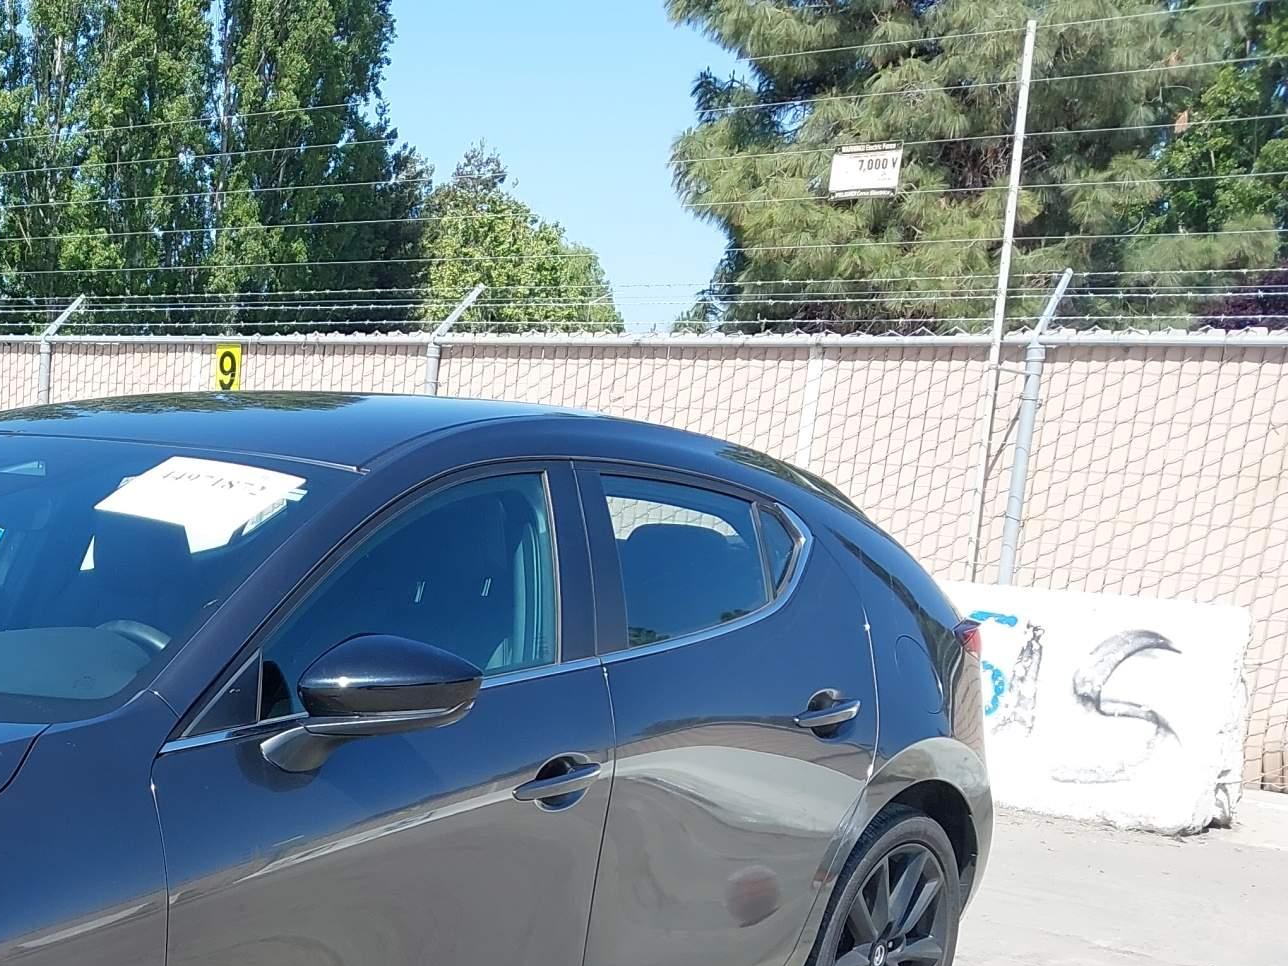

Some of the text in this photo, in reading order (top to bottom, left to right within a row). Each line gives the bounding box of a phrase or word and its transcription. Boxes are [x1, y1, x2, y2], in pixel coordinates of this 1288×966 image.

[858, 157, 898, 172] 7,000 V
[219, 350, 237, 390] 9
